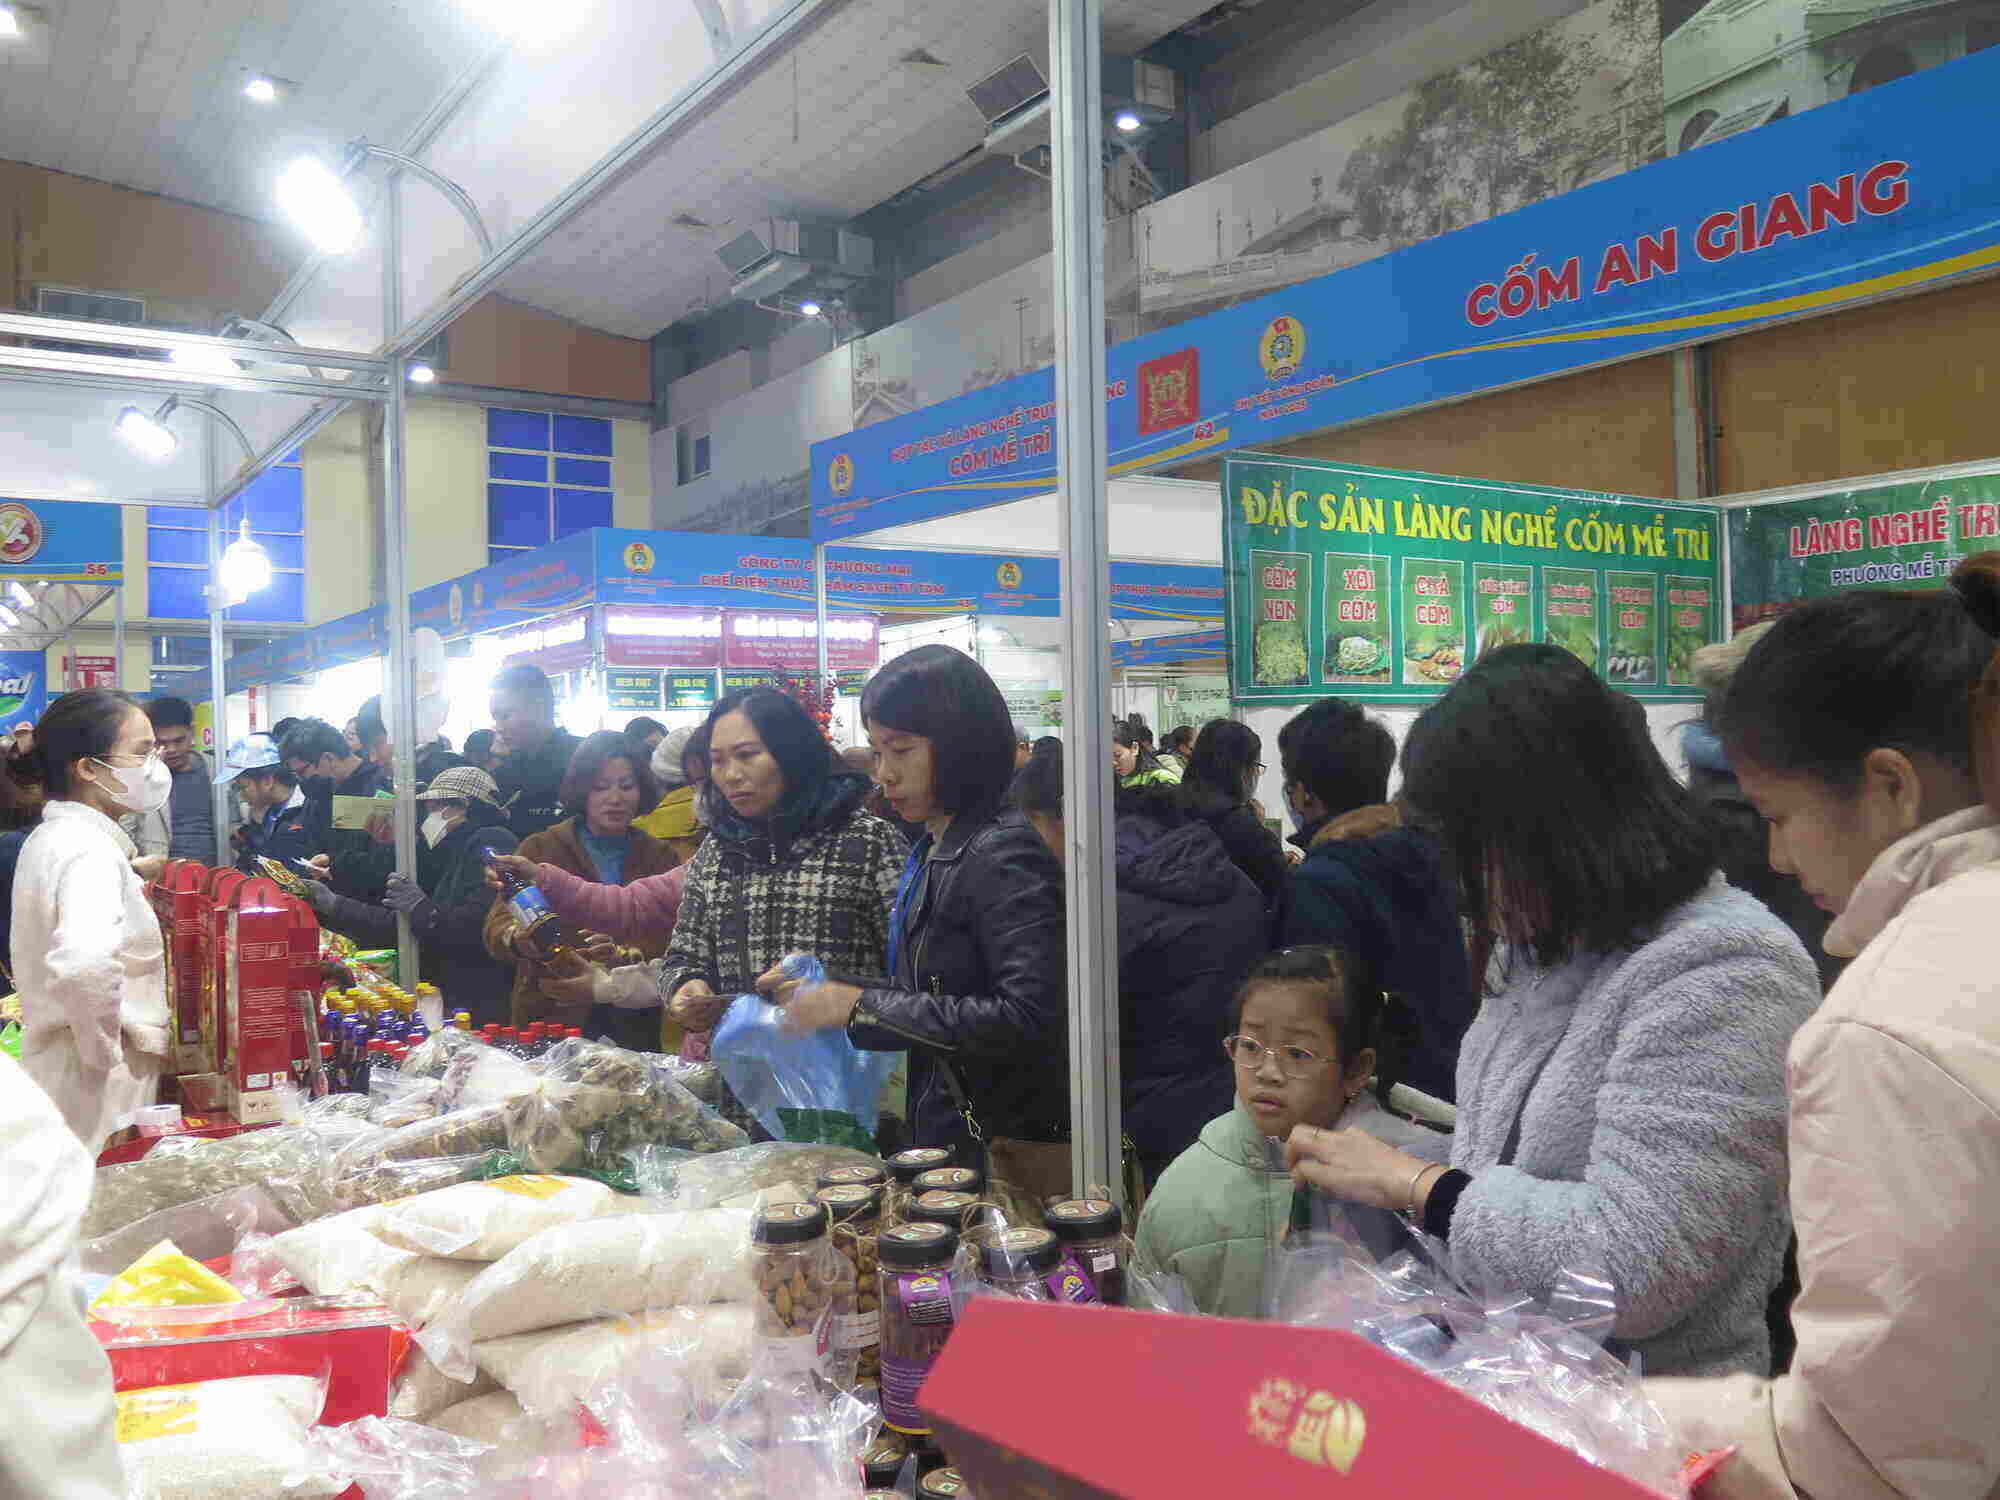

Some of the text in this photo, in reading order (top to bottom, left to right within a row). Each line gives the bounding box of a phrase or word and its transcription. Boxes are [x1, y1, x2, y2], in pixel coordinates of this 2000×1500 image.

[1465, 159, 1910, 327] CỐM AN GIANG
[948, 444, 987, 477] CỐM
[1241, 480, 1310, 536] ĐẶC
[1318, 482, 1386, 534] SẢN
[1391, 493, 1473, 542] LÀNG
[1480, 504, 1558, 550] NGHỀ
[1563, 511, 1626, 555] CỐM
[1632, 513, 1668, 558] MỄ
[1790, 517, 1863, 558] LÀNG
[1869, 496, 1952, 548] NGHỀ
[86, 563, 107, 576] 56
[1263, 560, 1297, 590] CỐM
[1343, 564, 1377, 591] XÔI
[1908, 552, 1934, 578] MỄ
[1263, 598, 1297, 621] NON
[1338, 593, 1378, 622] CỐM
[1415, 597, 1451, 625] CỐM
